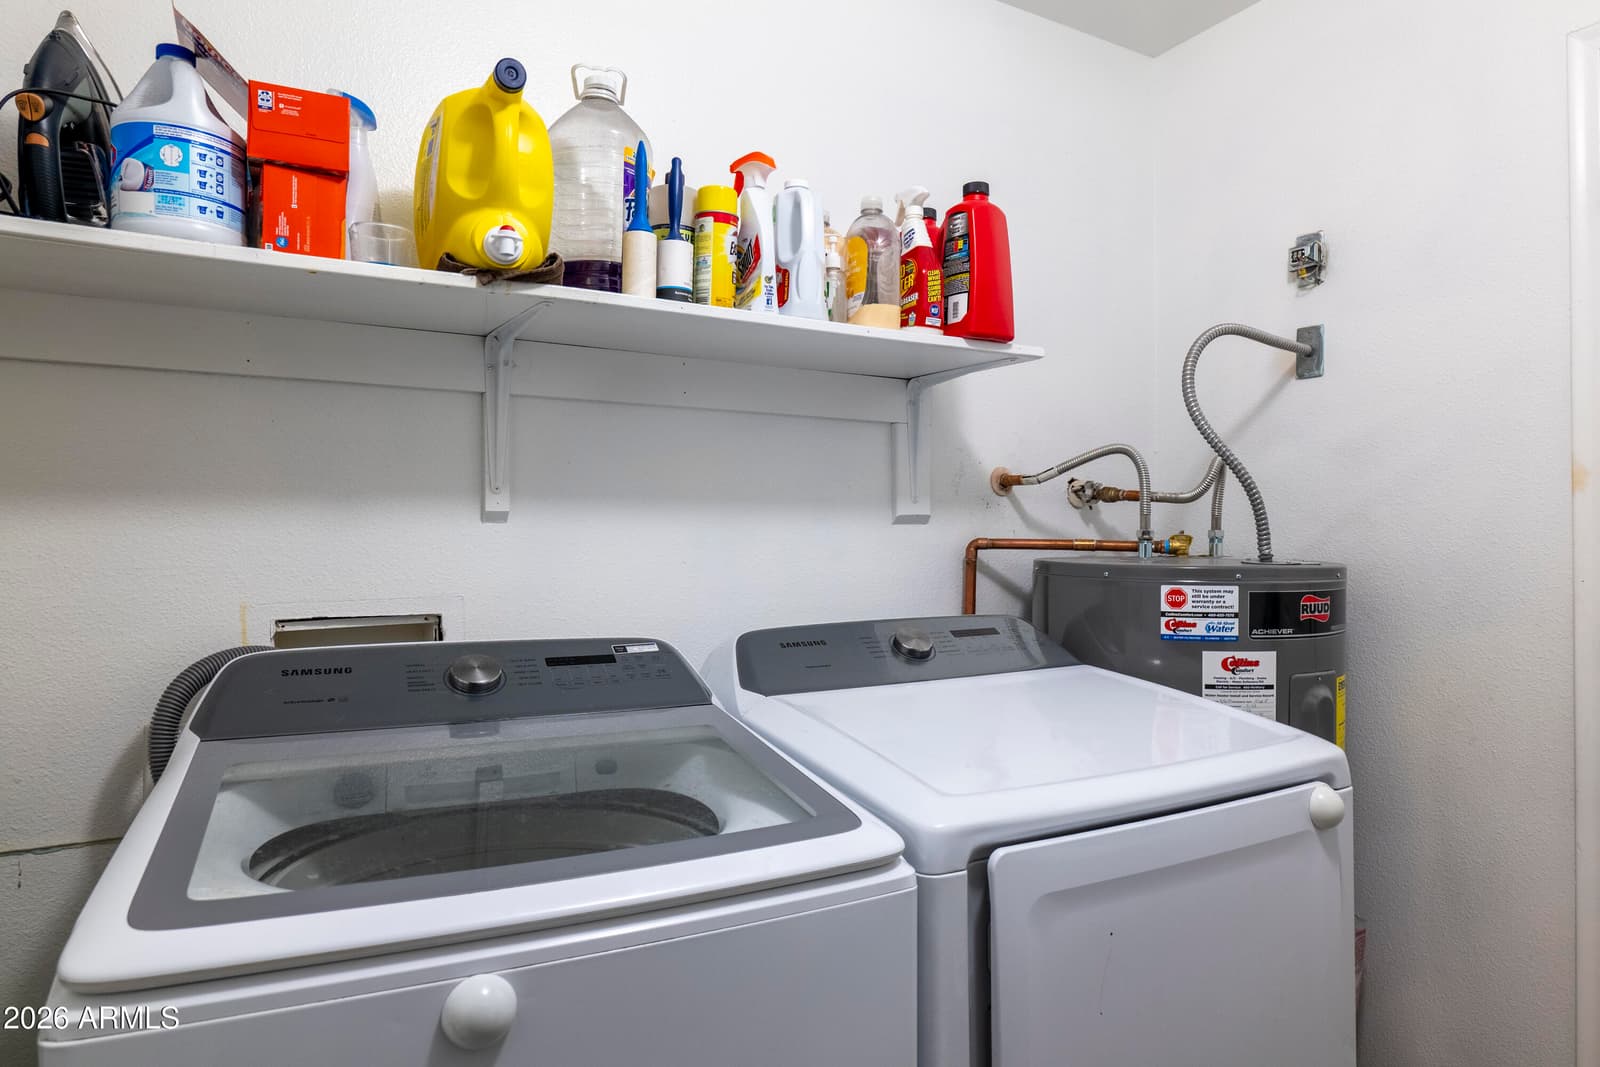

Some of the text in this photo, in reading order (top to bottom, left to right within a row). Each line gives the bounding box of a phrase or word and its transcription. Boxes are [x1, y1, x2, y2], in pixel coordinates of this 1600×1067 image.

[1301, 602, 1330, 614] RUUD
[1206, 624, 1235, 633] Water
[779, 639, 828, 649] SAMSUNG
[280, 667, 353, 677] SAMSUNG
